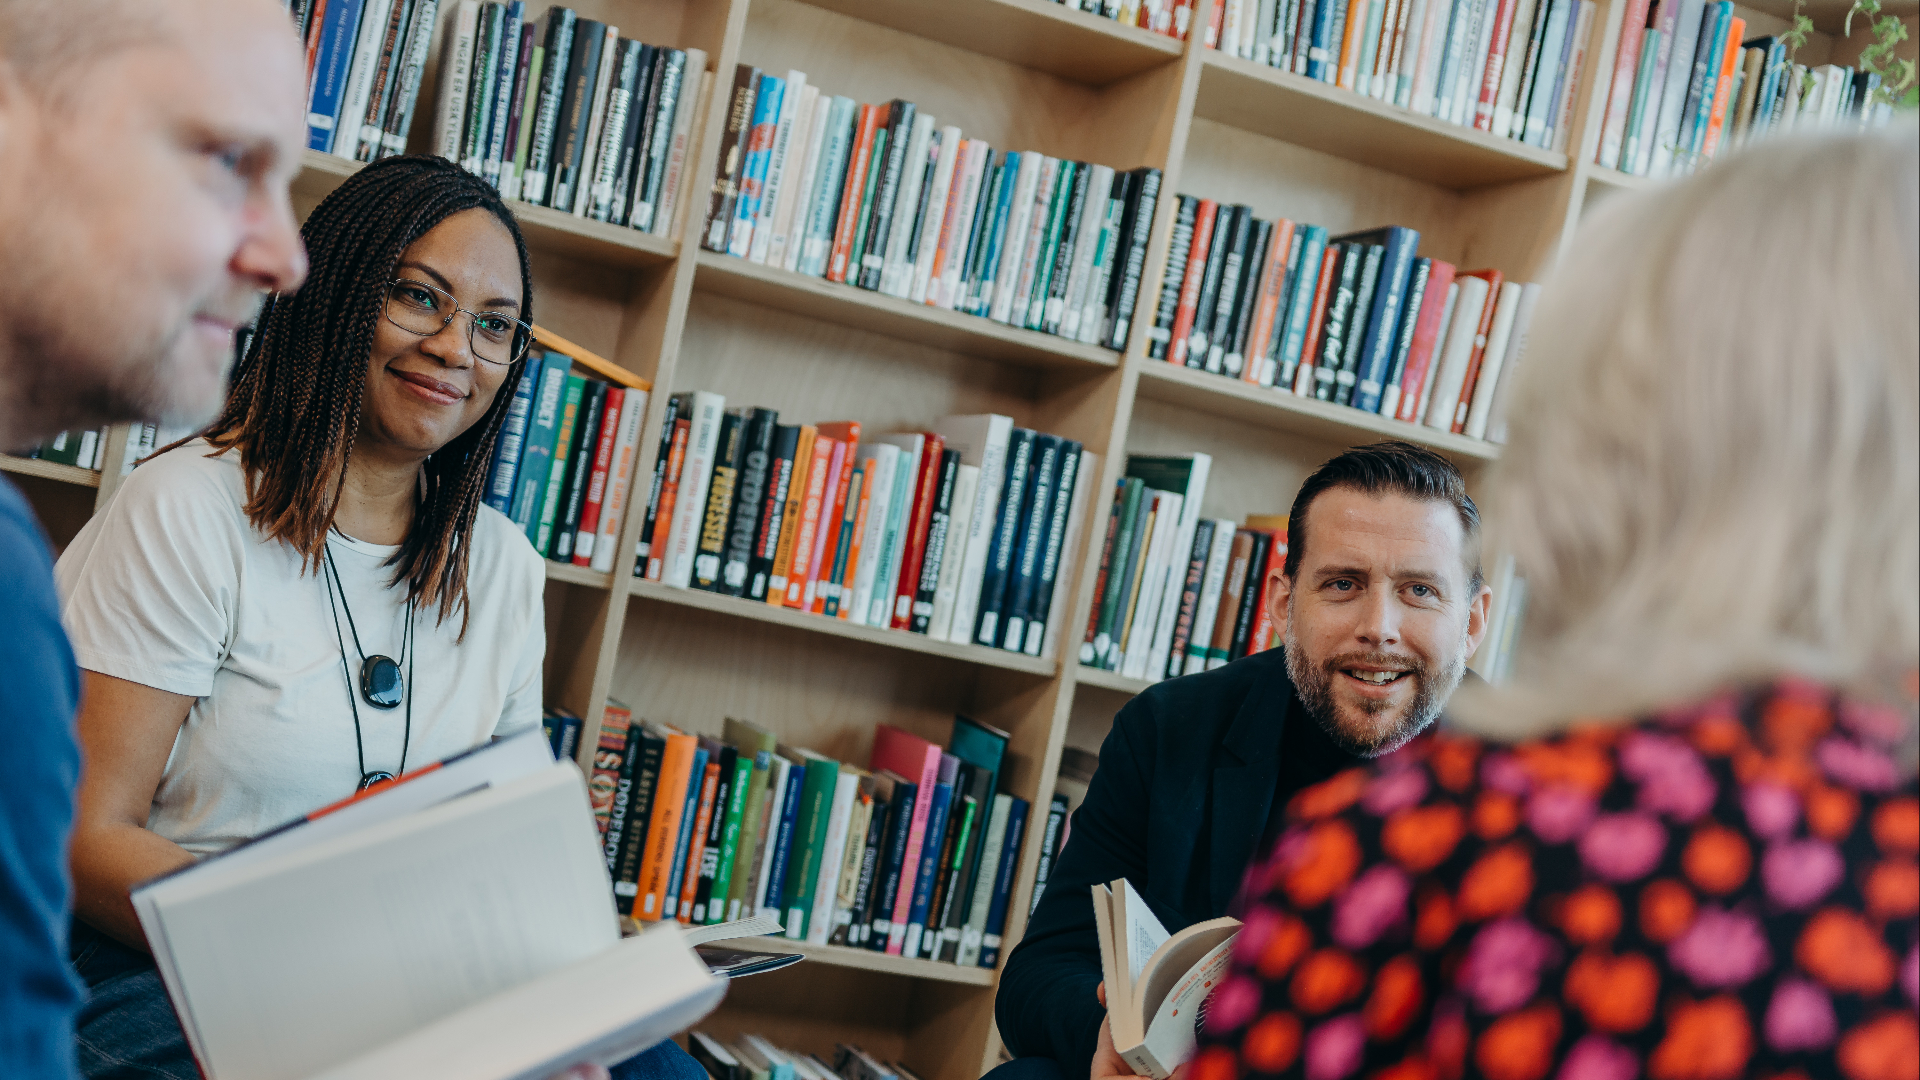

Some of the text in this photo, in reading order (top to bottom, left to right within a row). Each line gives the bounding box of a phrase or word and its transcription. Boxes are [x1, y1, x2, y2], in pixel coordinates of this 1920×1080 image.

[455, 35, 469, 74] INGEN
[452, 78, 463, 92] ER
[1012, 440, 1030, 479] NORSK
[1038, 446, 1055, 485] NORSK
[1059, 451, 1076, 491] NORSK
[700, 464, 738, 554] PROSESSEN
[792, 457, 827, 575] HODE OG HENDER
[1186, 558, 1202, 586] TIL
[698, 844, 720, 879] LESE
